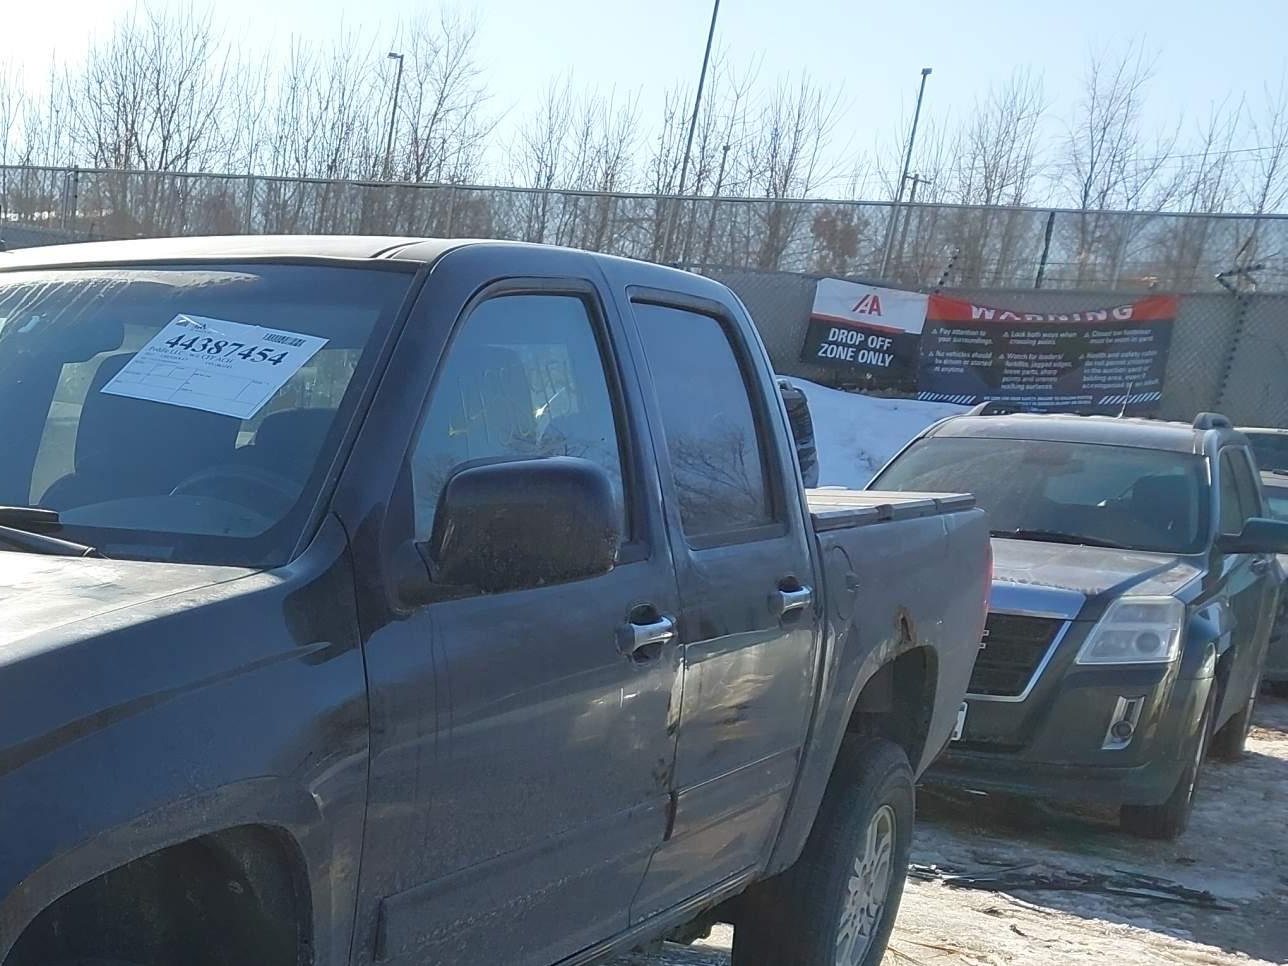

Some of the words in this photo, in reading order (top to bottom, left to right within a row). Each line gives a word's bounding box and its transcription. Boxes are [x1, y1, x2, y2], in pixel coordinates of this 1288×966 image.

[166, 334, 289, 365] 44387454
[828, 327, 865, 346] DROP
[867, 336, 893, 350] OFF
[817, 343, 857, 361] ZONE
[858, 349, 894, 367] ONLY
